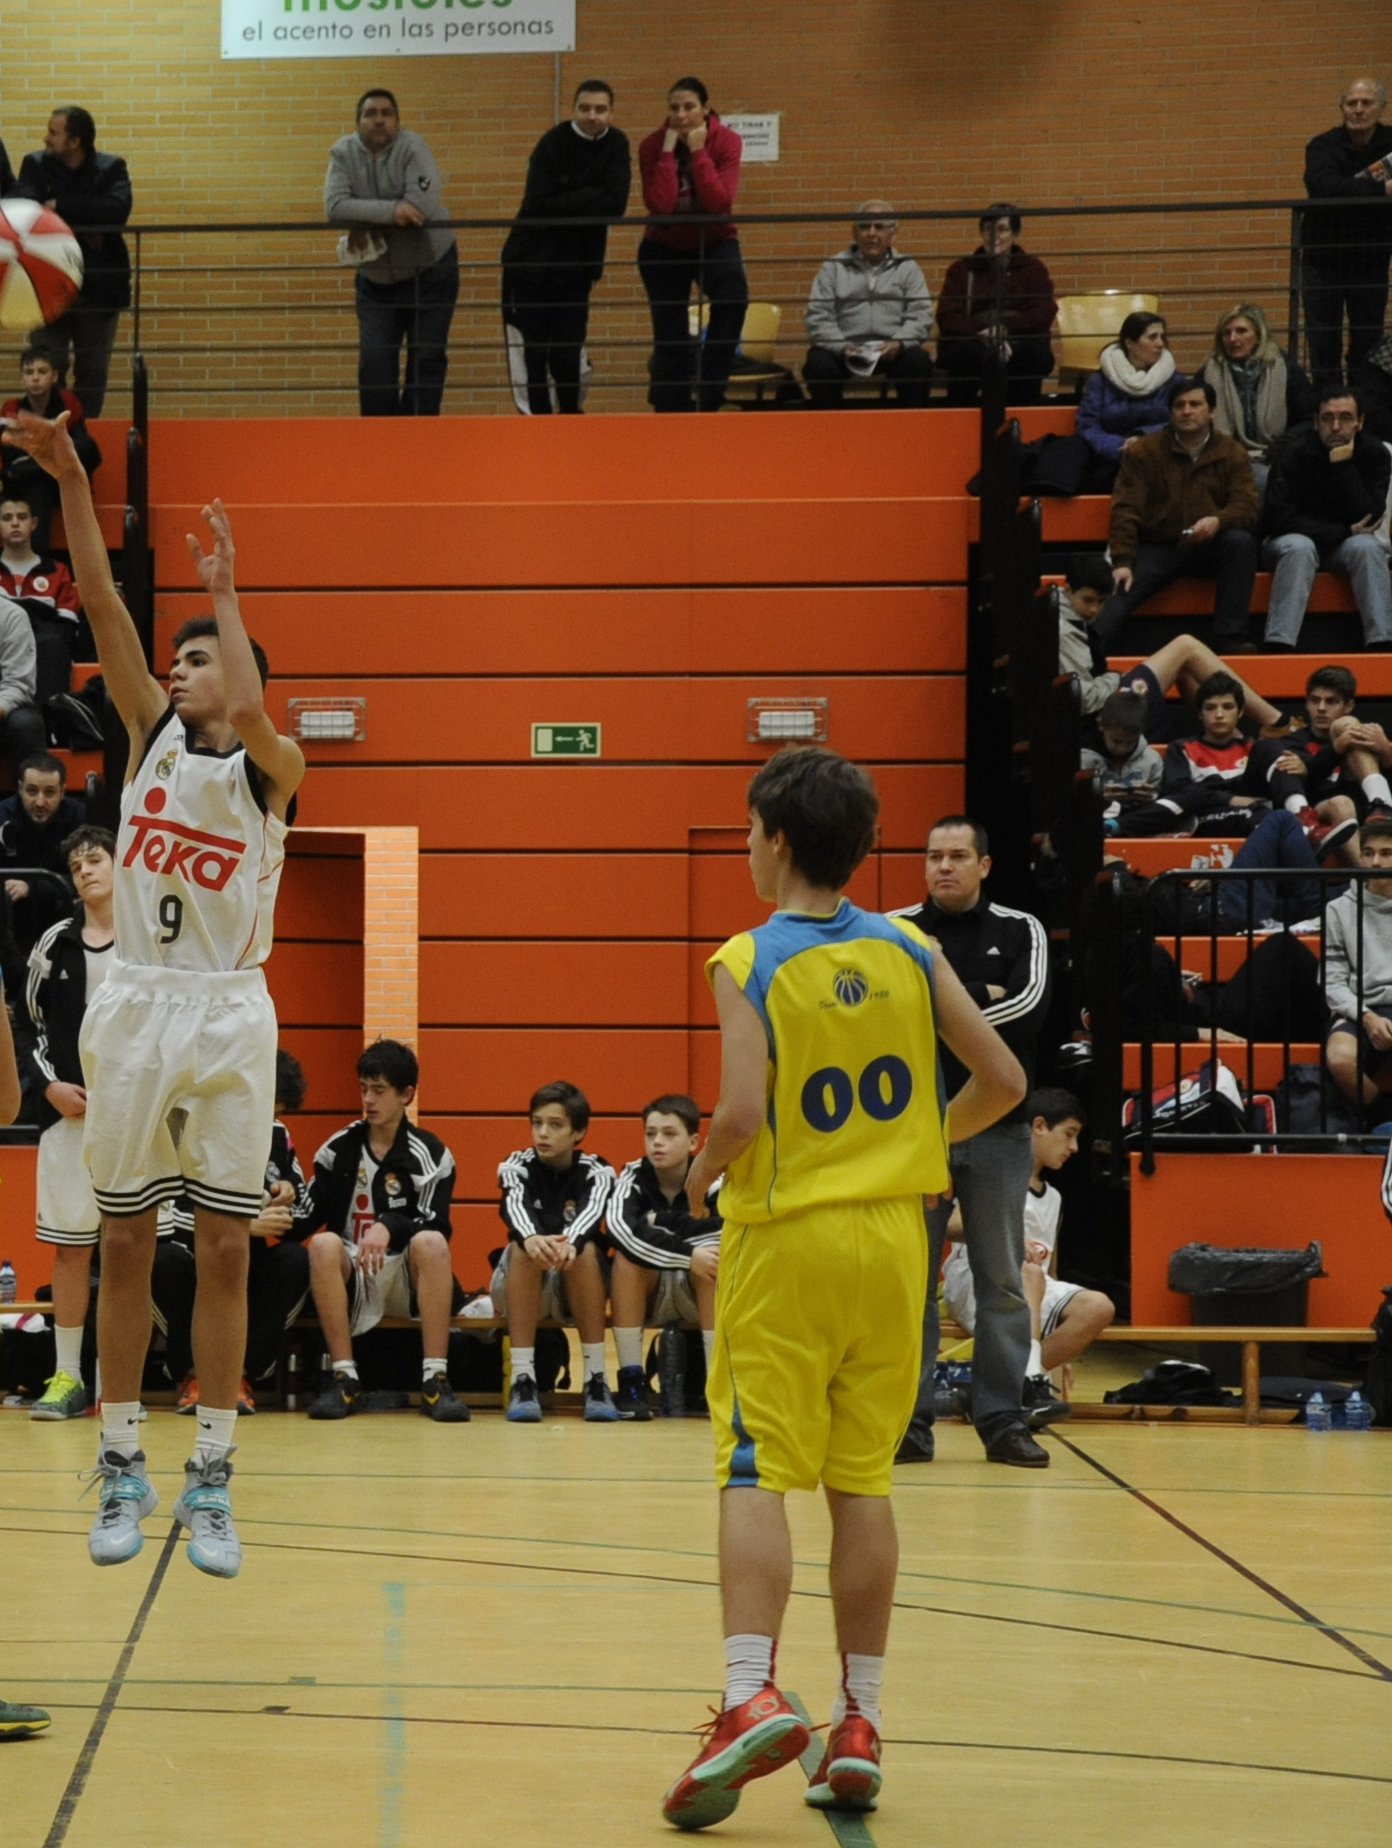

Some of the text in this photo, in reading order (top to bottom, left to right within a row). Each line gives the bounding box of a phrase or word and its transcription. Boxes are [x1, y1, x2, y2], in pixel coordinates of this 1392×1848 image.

[242, 18, 554, 43] el acento en las personas
[122, 814, 248, 892] Teka
[160, 894, 183, 944] 9
[800, 1053, 913, 1134] 00
